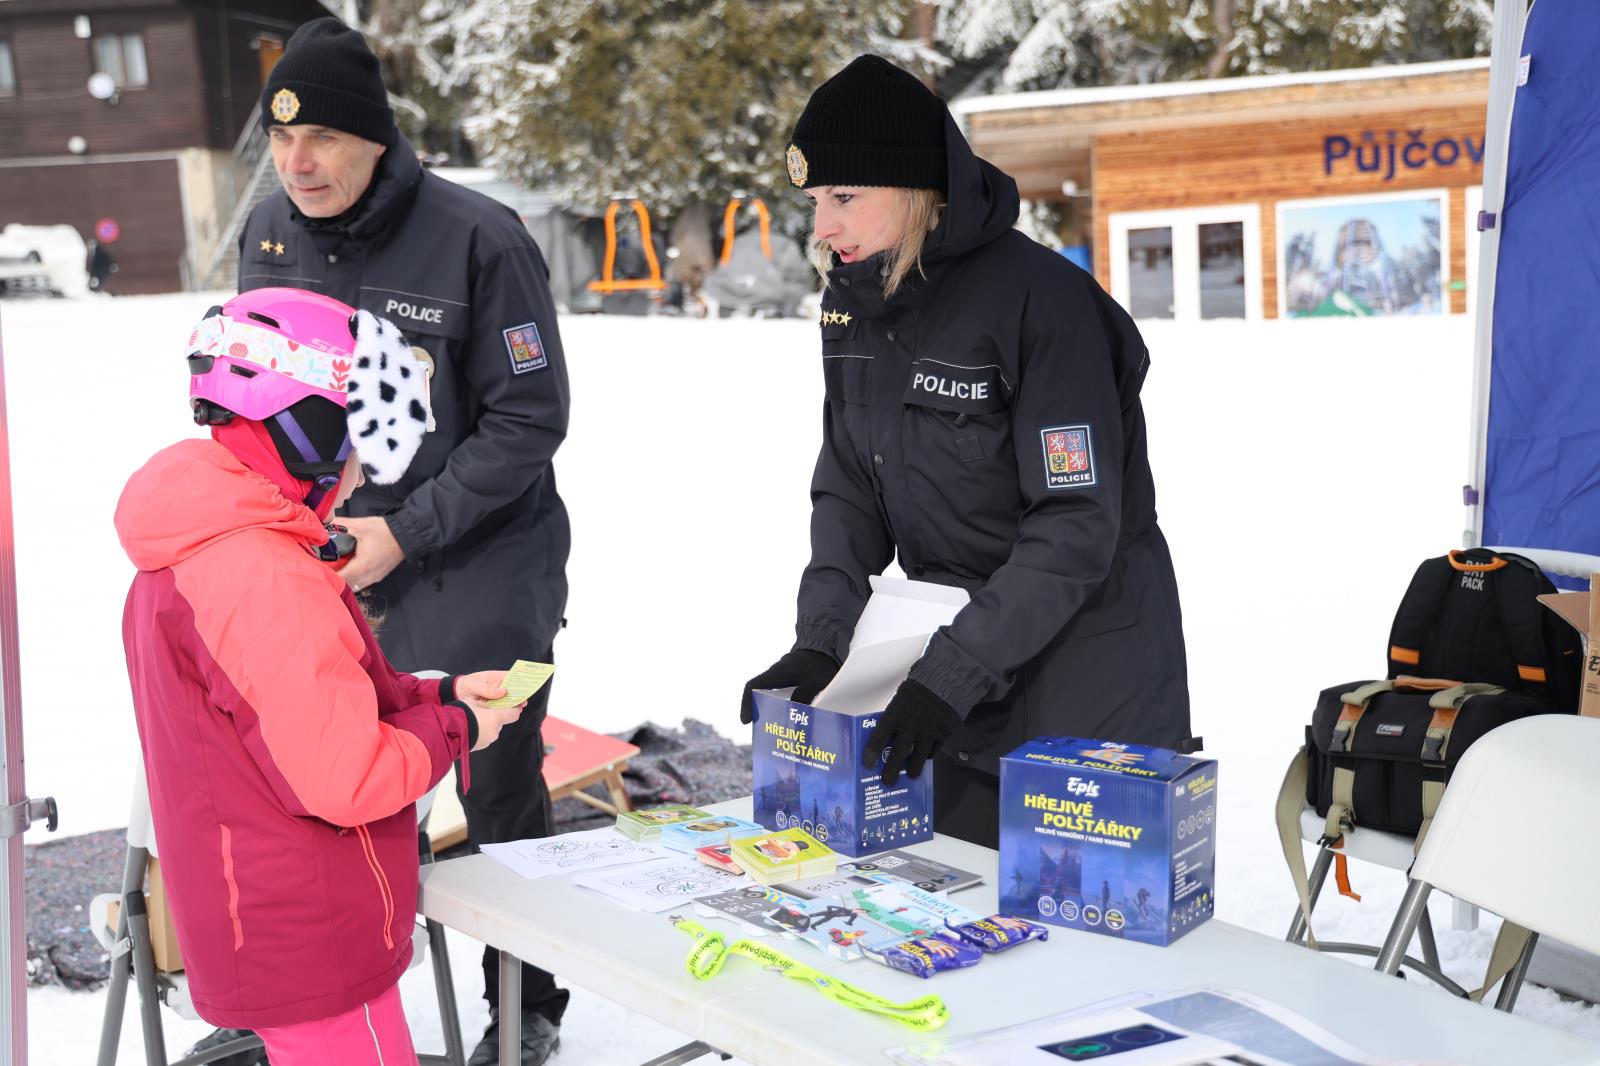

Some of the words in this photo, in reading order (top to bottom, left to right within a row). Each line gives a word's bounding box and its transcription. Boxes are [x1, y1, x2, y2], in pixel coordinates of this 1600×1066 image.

[385, 299, 444, 323] POLICE
[912, 373, 989, 400] POLICIE
[1050, 473, 1092, 484] POLICIE
[1461, 576, 1485, 591] PACK
[789, 707, 809, 726] Epis
[862, 718, 877, 729] Epis
[765, 721, 806, 743] HŘEJIVÉ
[776, 738, 837, 764] POLŠTÁŘKY
[1066, 776, 1101, 797] Epis
[1024, 793, 1094, 817] HŘEJIVÉ
[1043, 812, 1143, 840] POLŠTÁŘKY
